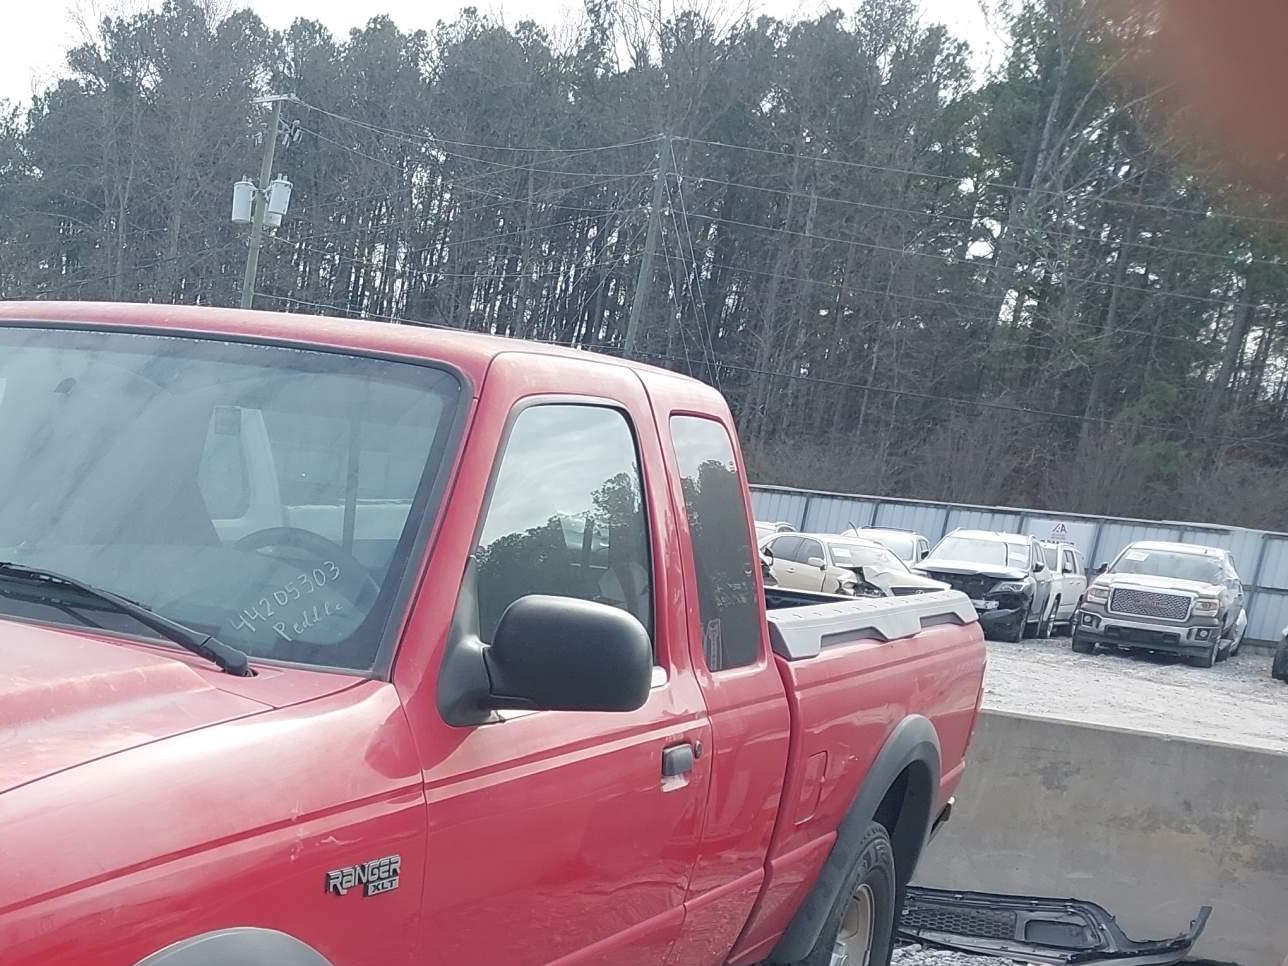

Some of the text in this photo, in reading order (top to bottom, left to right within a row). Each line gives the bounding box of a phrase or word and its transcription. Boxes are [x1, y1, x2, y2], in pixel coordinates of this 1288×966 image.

[232, 561, 341, 633] 44205303
[326, 854, 402, 896] RANGER
[371, 878, 397, 894] XLT
